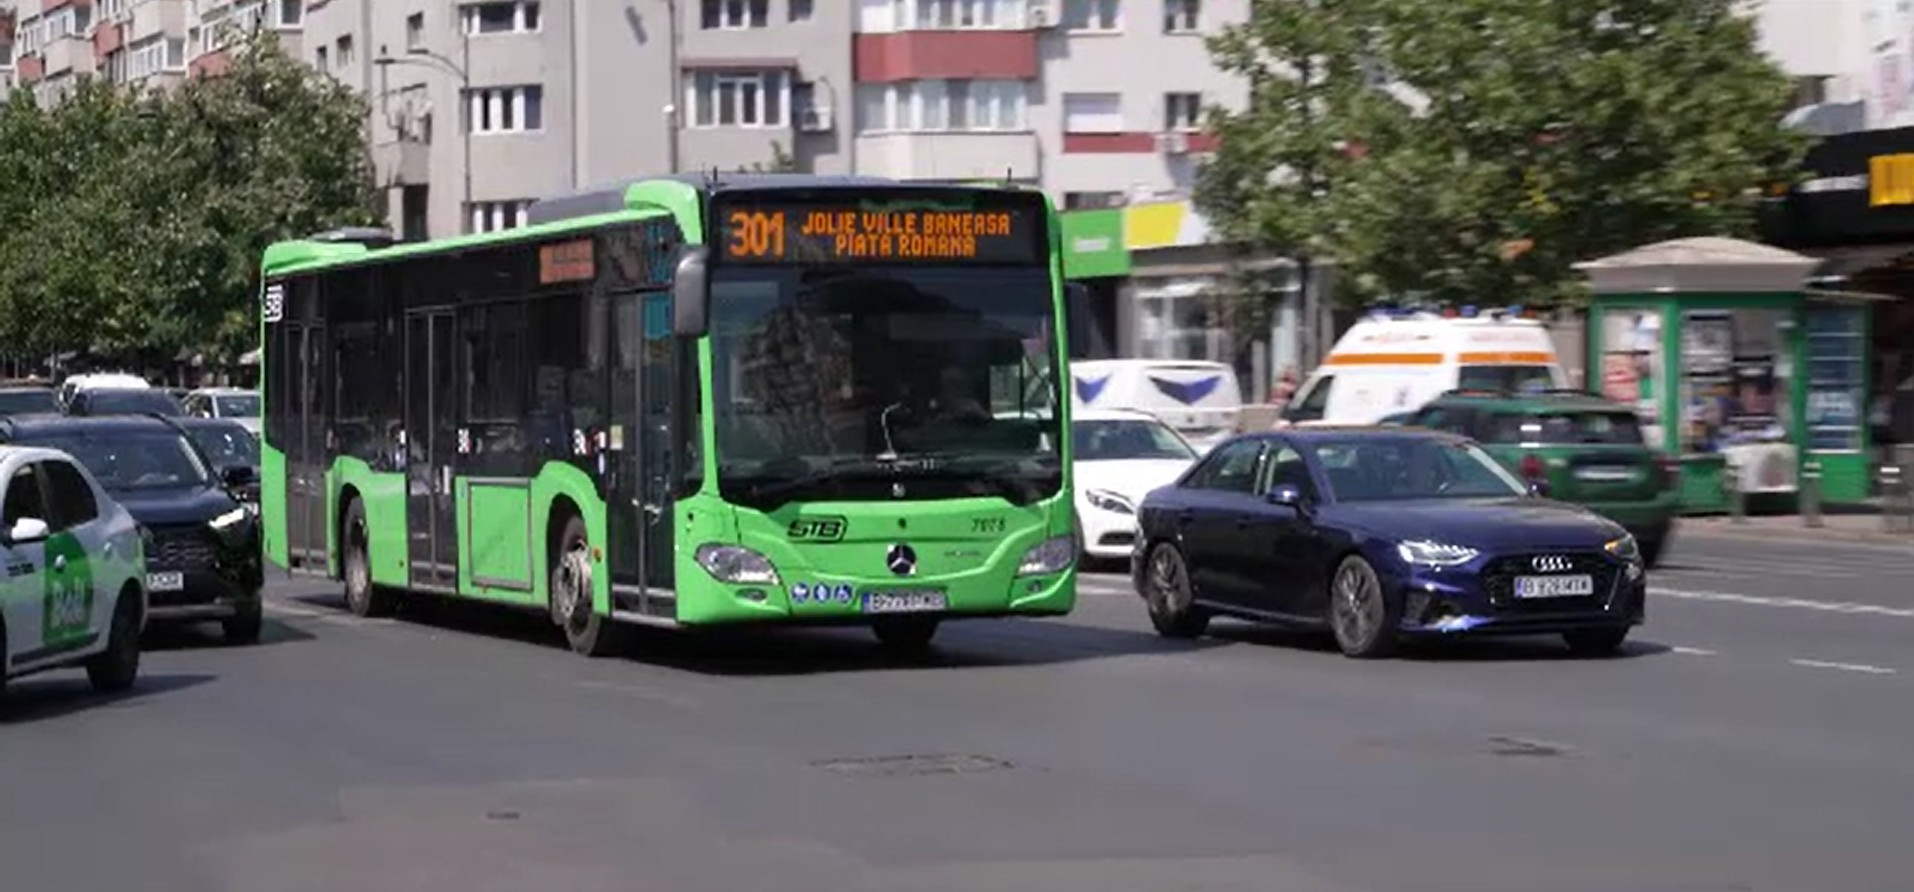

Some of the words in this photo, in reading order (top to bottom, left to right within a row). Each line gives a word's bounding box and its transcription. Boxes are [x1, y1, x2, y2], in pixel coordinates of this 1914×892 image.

[728, 211, 785, 257] 301
[802, 211, 856, 235] JOLIE
[862, 211, 915, 235] VILLE
[922, 211, 1011, 236] BANEASA
[835, 234, 892, 257] PIATA
[898, 234, 977, 258] ROMANA
[787, 517, 843, 539] STB
